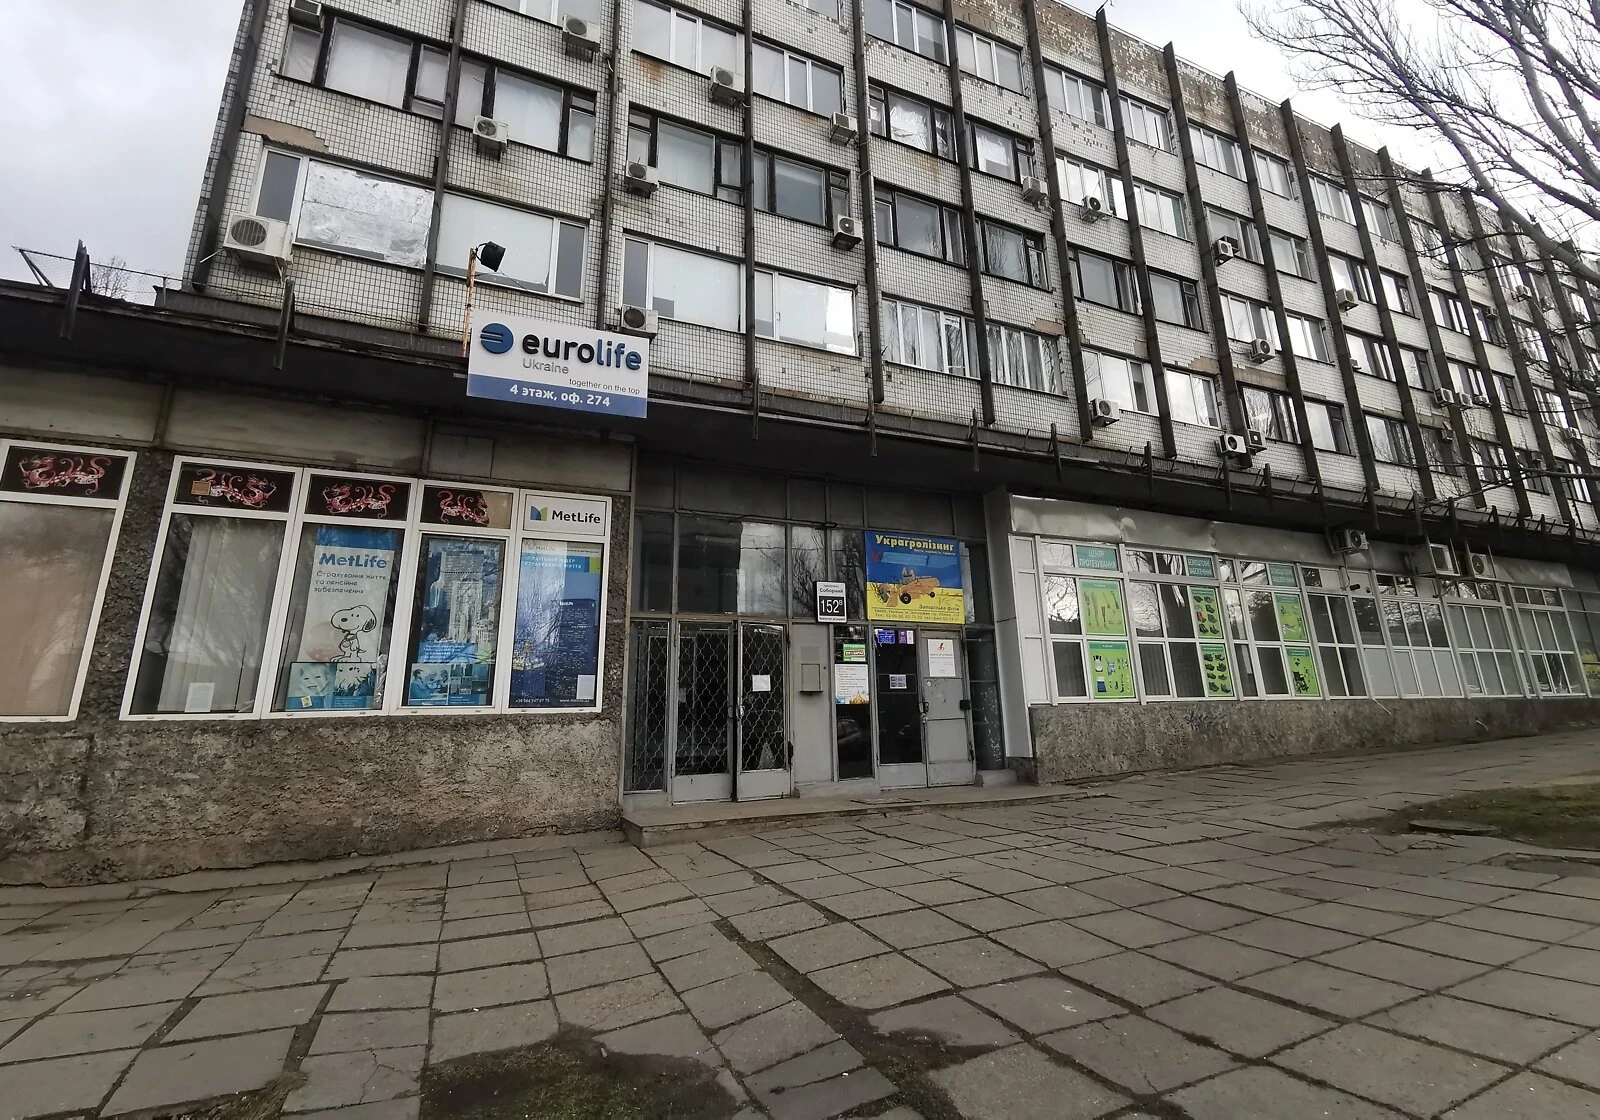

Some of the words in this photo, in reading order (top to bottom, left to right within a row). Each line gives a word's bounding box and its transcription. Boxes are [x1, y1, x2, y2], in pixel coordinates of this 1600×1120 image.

[522, 333, 642, 371] eurolife
[522, 358, 569, 375] Ukraine
[569, 378, 601, 390] together
[614, 384, 626, 392] the
[628, 386, 640, 395] top
[509, 384, 518, 395] 4
[521, 387, 557, 401] этаж,
[561, 391, 584, 405] оф.
[586, 394, 611, 407] 274
[551, 509, 601, 524] MetLife
[875, 534, 954, 551] Украгролізинг
[319, 552, 387, 569] MetLife
